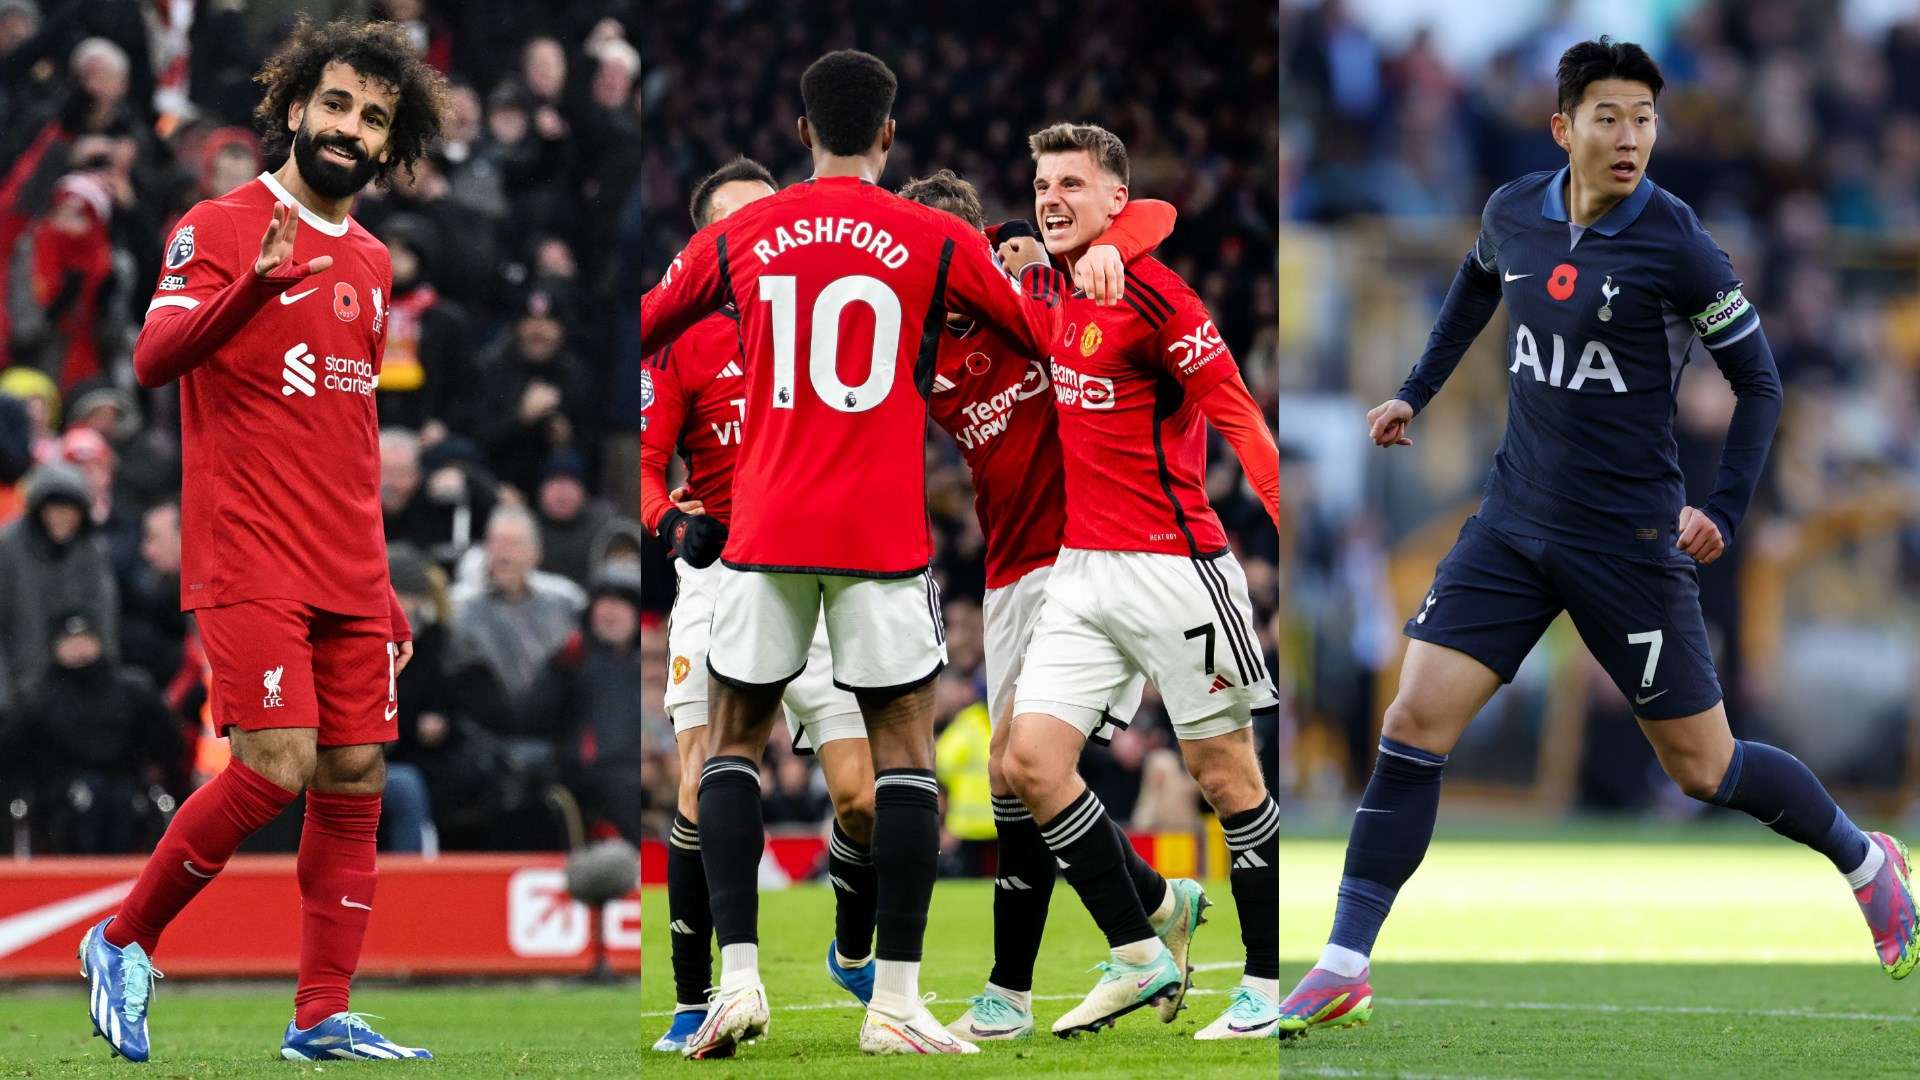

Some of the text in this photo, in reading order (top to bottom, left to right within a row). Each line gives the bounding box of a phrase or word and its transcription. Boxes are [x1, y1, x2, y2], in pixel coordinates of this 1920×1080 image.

[753, 217, 909, 270] RASHFORD
[324, 353, 372, 378] standa
[758, 275, 901, 412] 10
[1183, 343, 1228, 376] TECHNOLOG
[1508, 323, 1629, 393] AIA
[711, 420, 742, 446] Vi
[729, 398, 747, 424] T
[955, 408, 1014, 450] View
[1183, 622, 1216, 676] 7
[1627, 629, 1664, 688] 7
